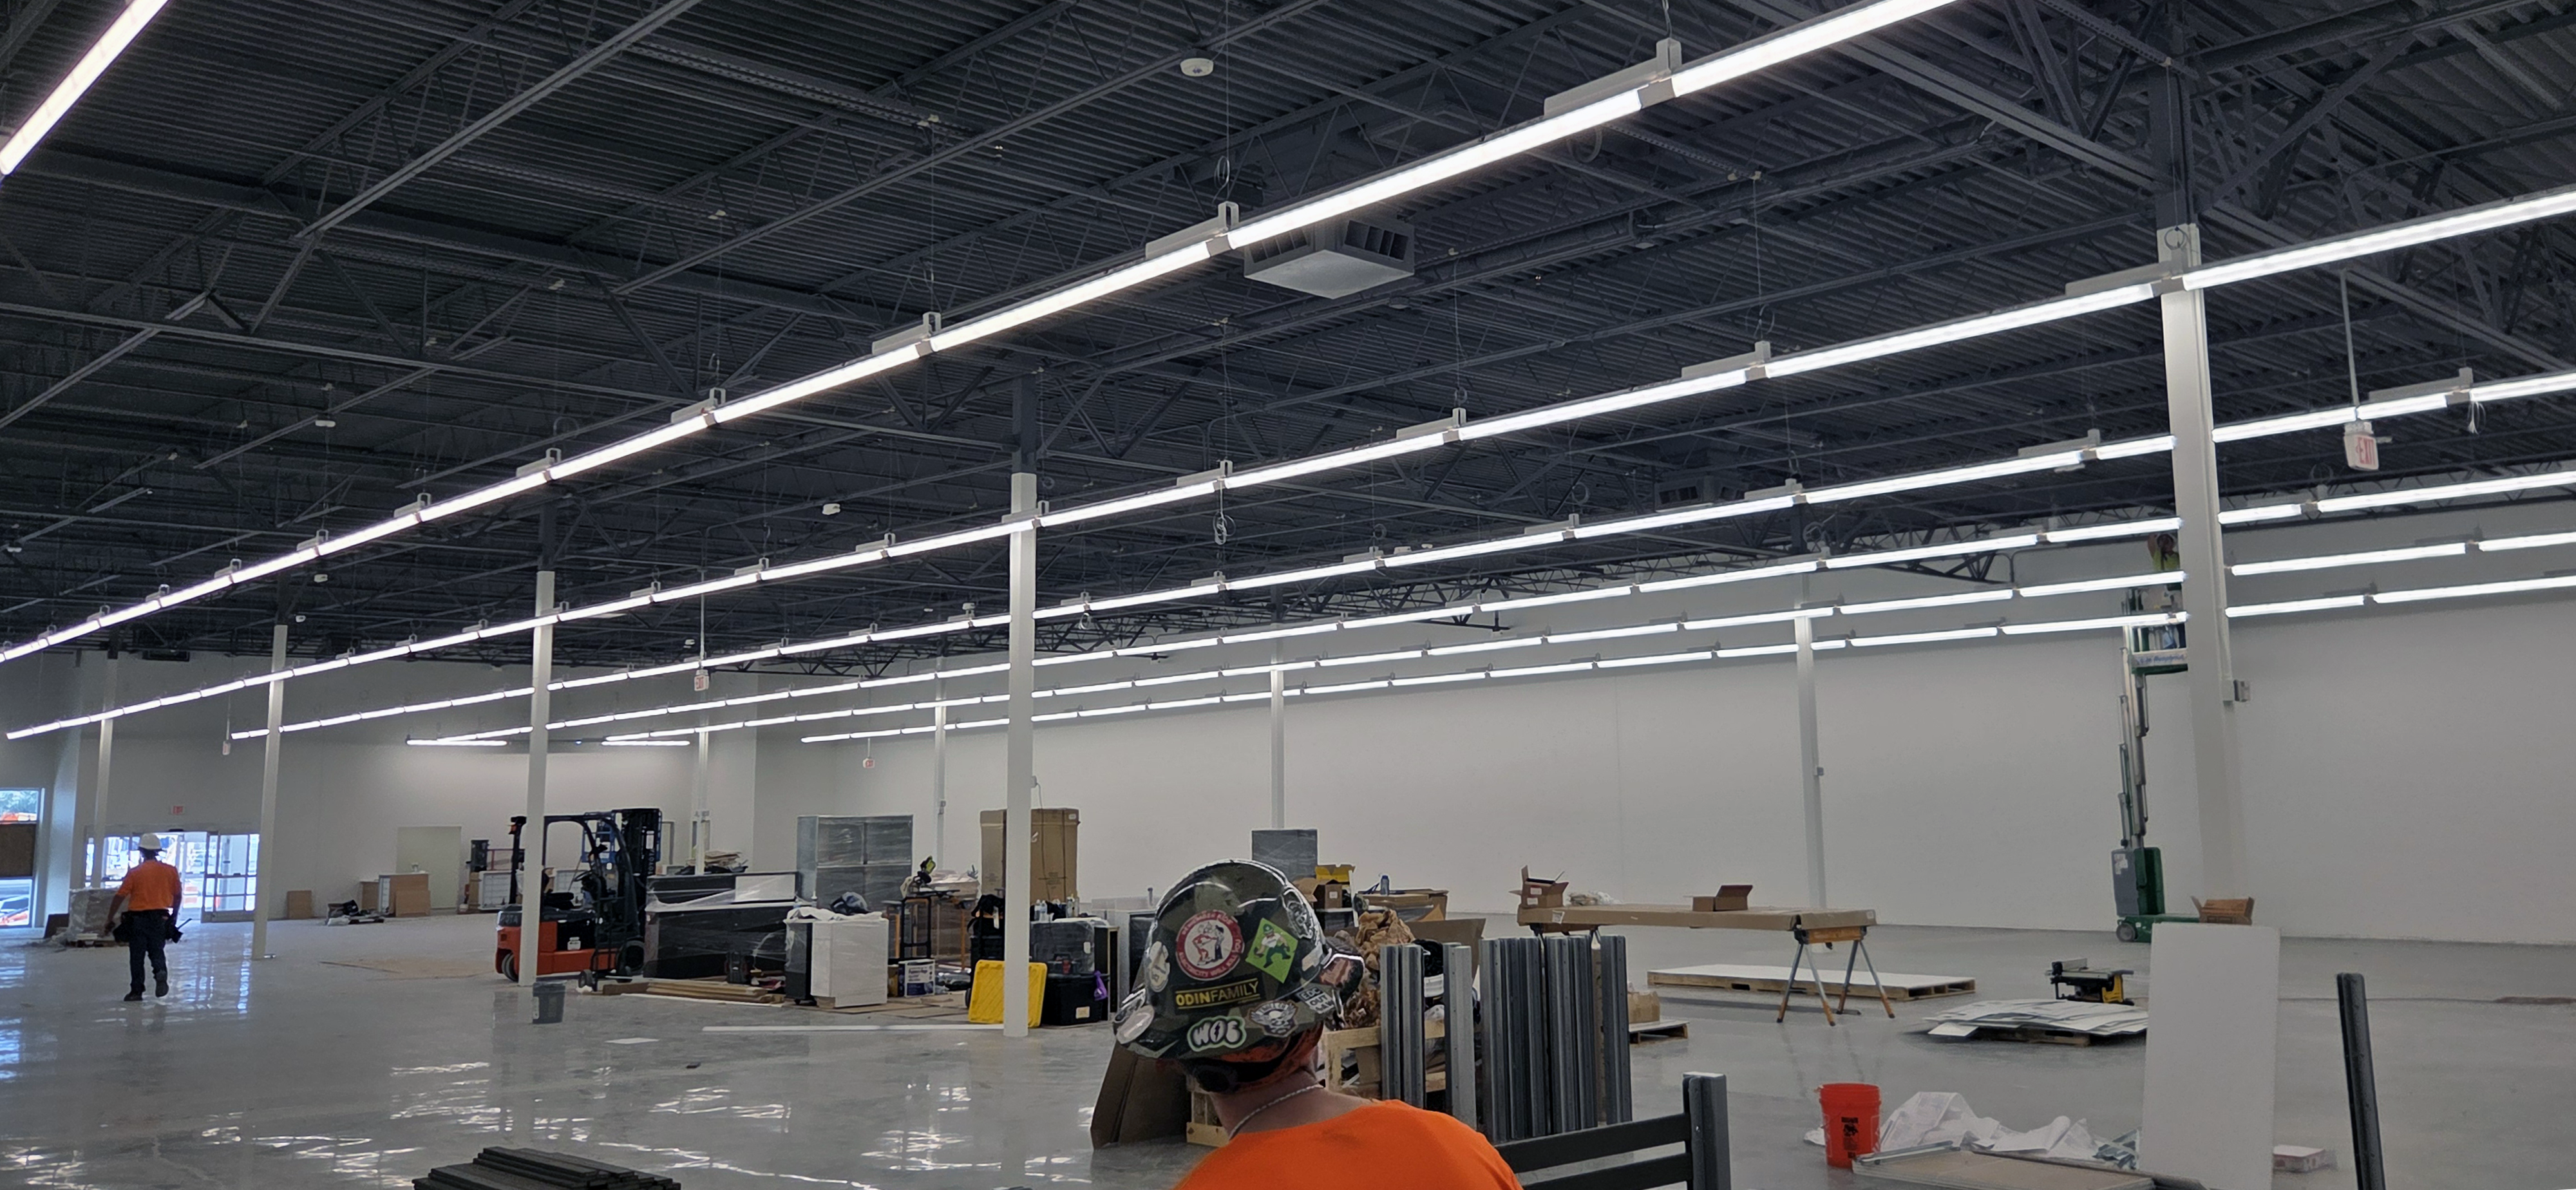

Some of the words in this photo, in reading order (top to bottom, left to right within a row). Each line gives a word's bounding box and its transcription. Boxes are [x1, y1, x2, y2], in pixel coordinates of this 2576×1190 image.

[2357, 437, 2376, 464] EXIT
[1175, 980, 1259, 1006] ODINFAMILY
[1300, 987, 1321, 1001] EDC
[1309, 994, 1329, 1006] OUT
